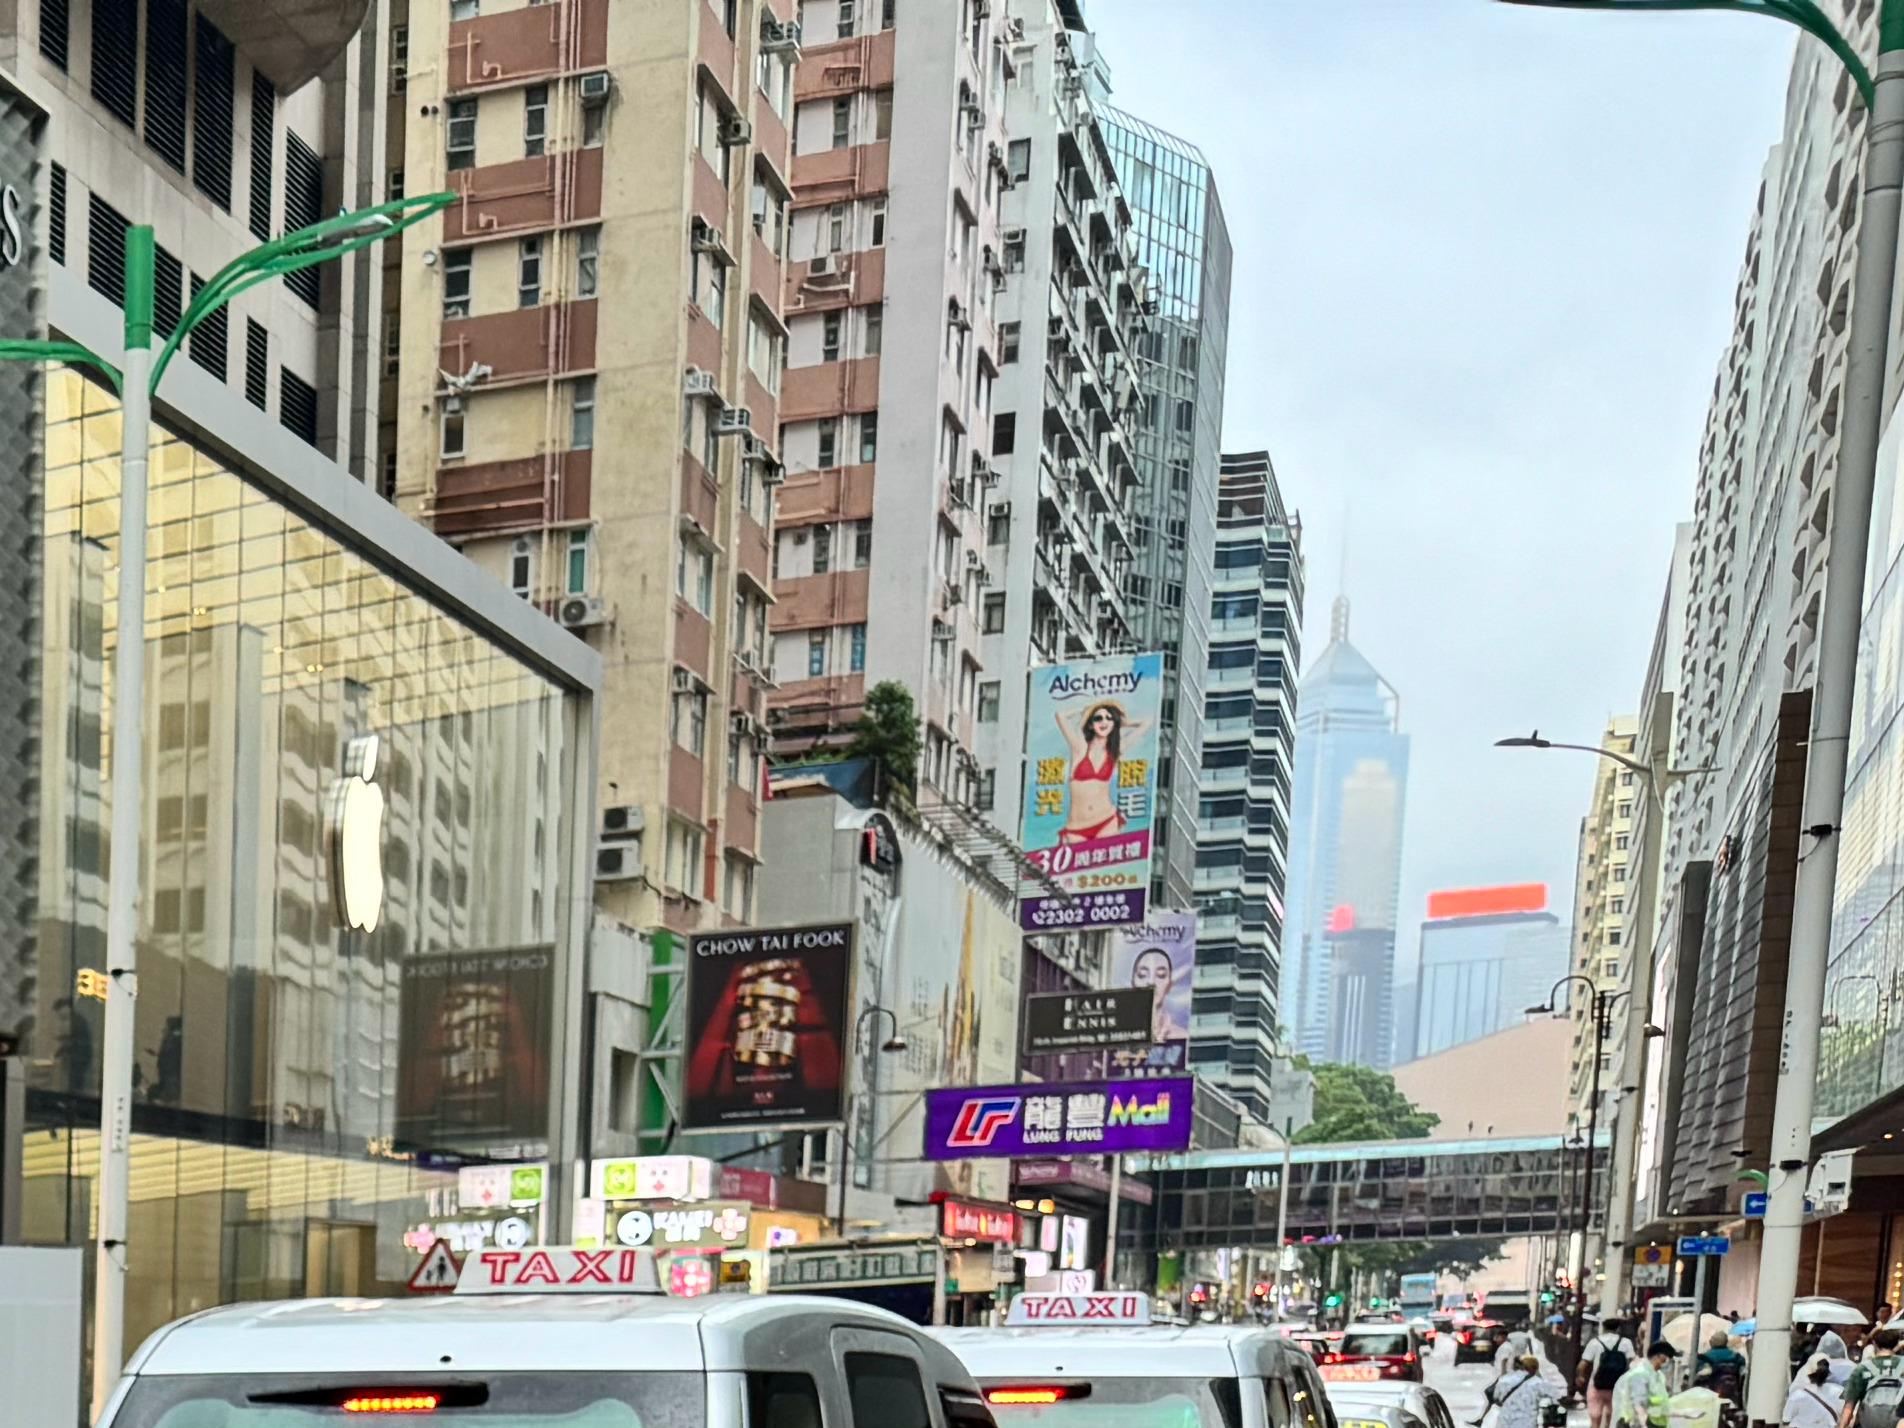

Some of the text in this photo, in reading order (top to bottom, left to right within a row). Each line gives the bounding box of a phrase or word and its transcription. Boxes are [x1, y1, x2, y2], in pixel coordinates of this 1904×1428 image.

[1049, 672, 1143, 694] Alchemy
[1046, 905, 1130, 925] 2302 0002
[696, 930, 844, 957] CHOW TAI FOOK
[1107, 1092, 1170, 1127] Mall
[1022, 1130, 1060, 1144] LUNG
[481, 1250, 636, 1284] TAXI
[1022, 1297, 1137, 1319] TAXI
